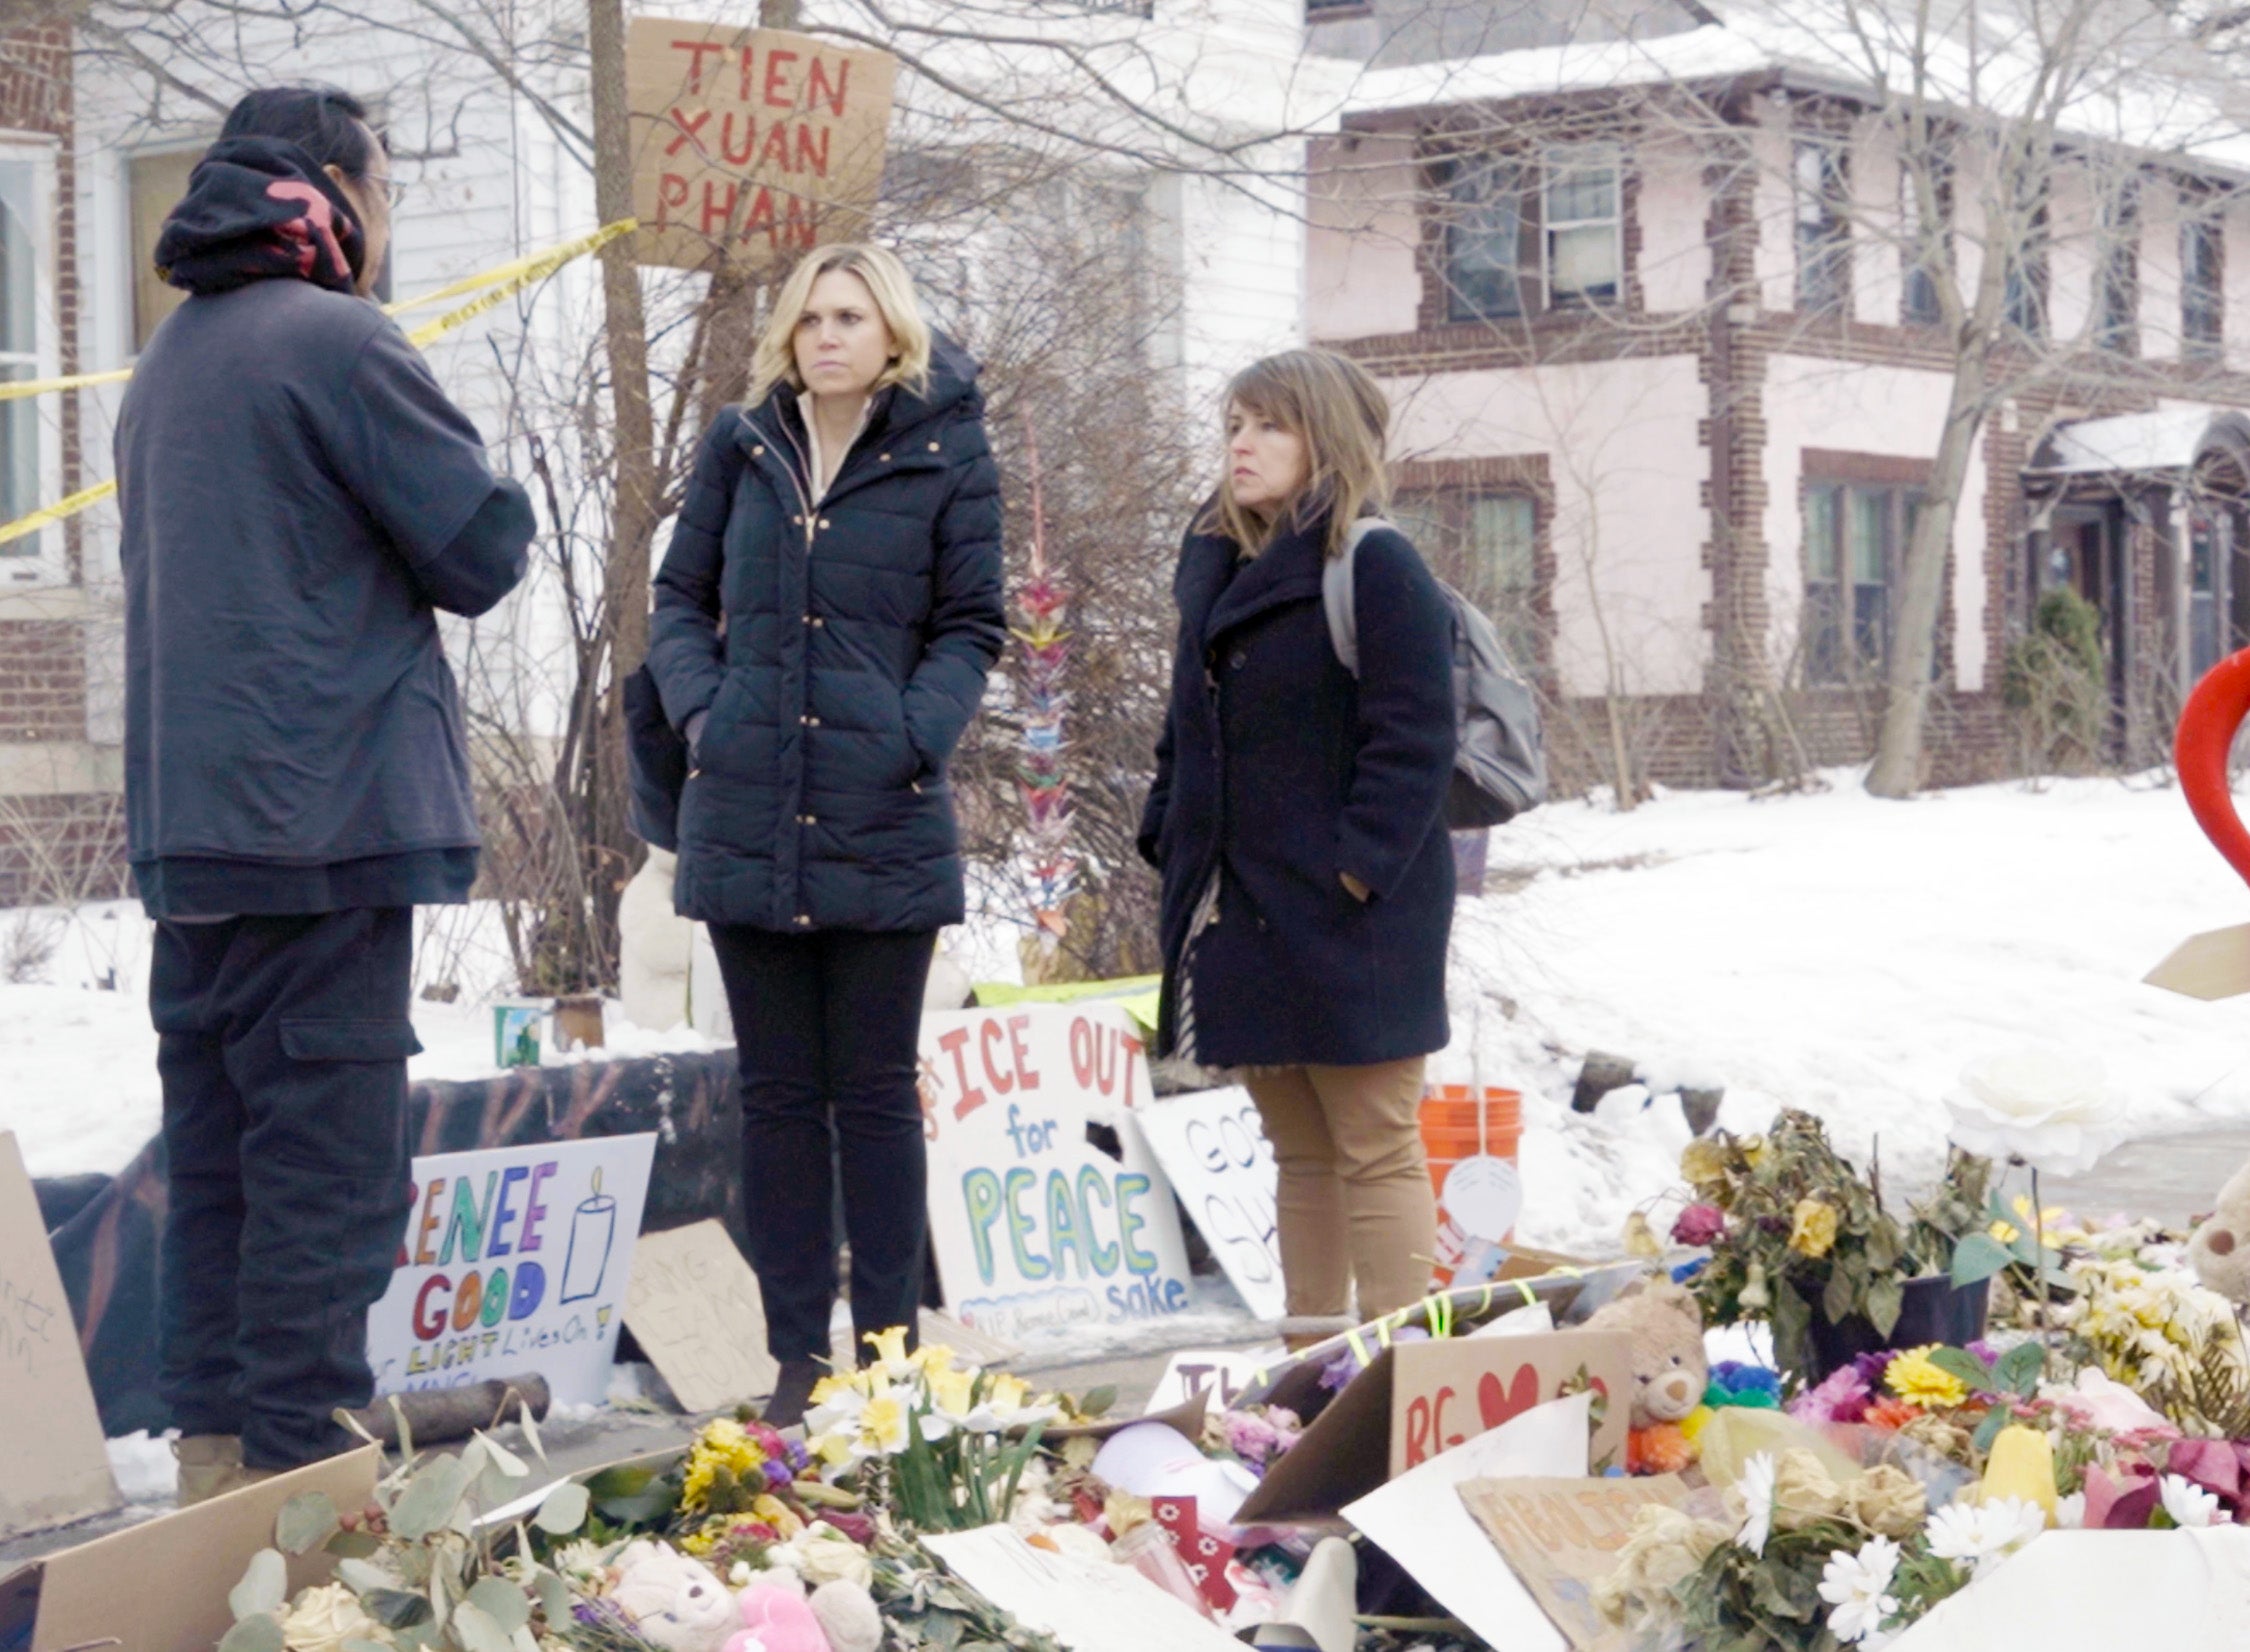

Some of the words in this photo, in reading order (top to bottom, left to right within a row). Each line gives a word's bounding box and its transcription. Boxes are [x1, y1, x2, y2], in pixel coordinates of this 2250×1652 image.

[669, 39, 850, 118] TIEN
[664, 106, 830, 179] XUAN
[655, 172, 817, 250] PHAN
[937, 1014, 1040, 1123] ICE
[1068, 1015, 1145, 1108] OUT
[1005, 1103, 1058, 1159] for
[961, 1163, 1159, 1288] PEACE
[412, 1260, 547, 1342] GOOD
[1105, 1273, 1189, 1325] sake
[406, 1331, 500, 1376] LIGHT
[502, 1327, 560, 1355] Lives
[1406, 1386, 1465, 1470] RG
